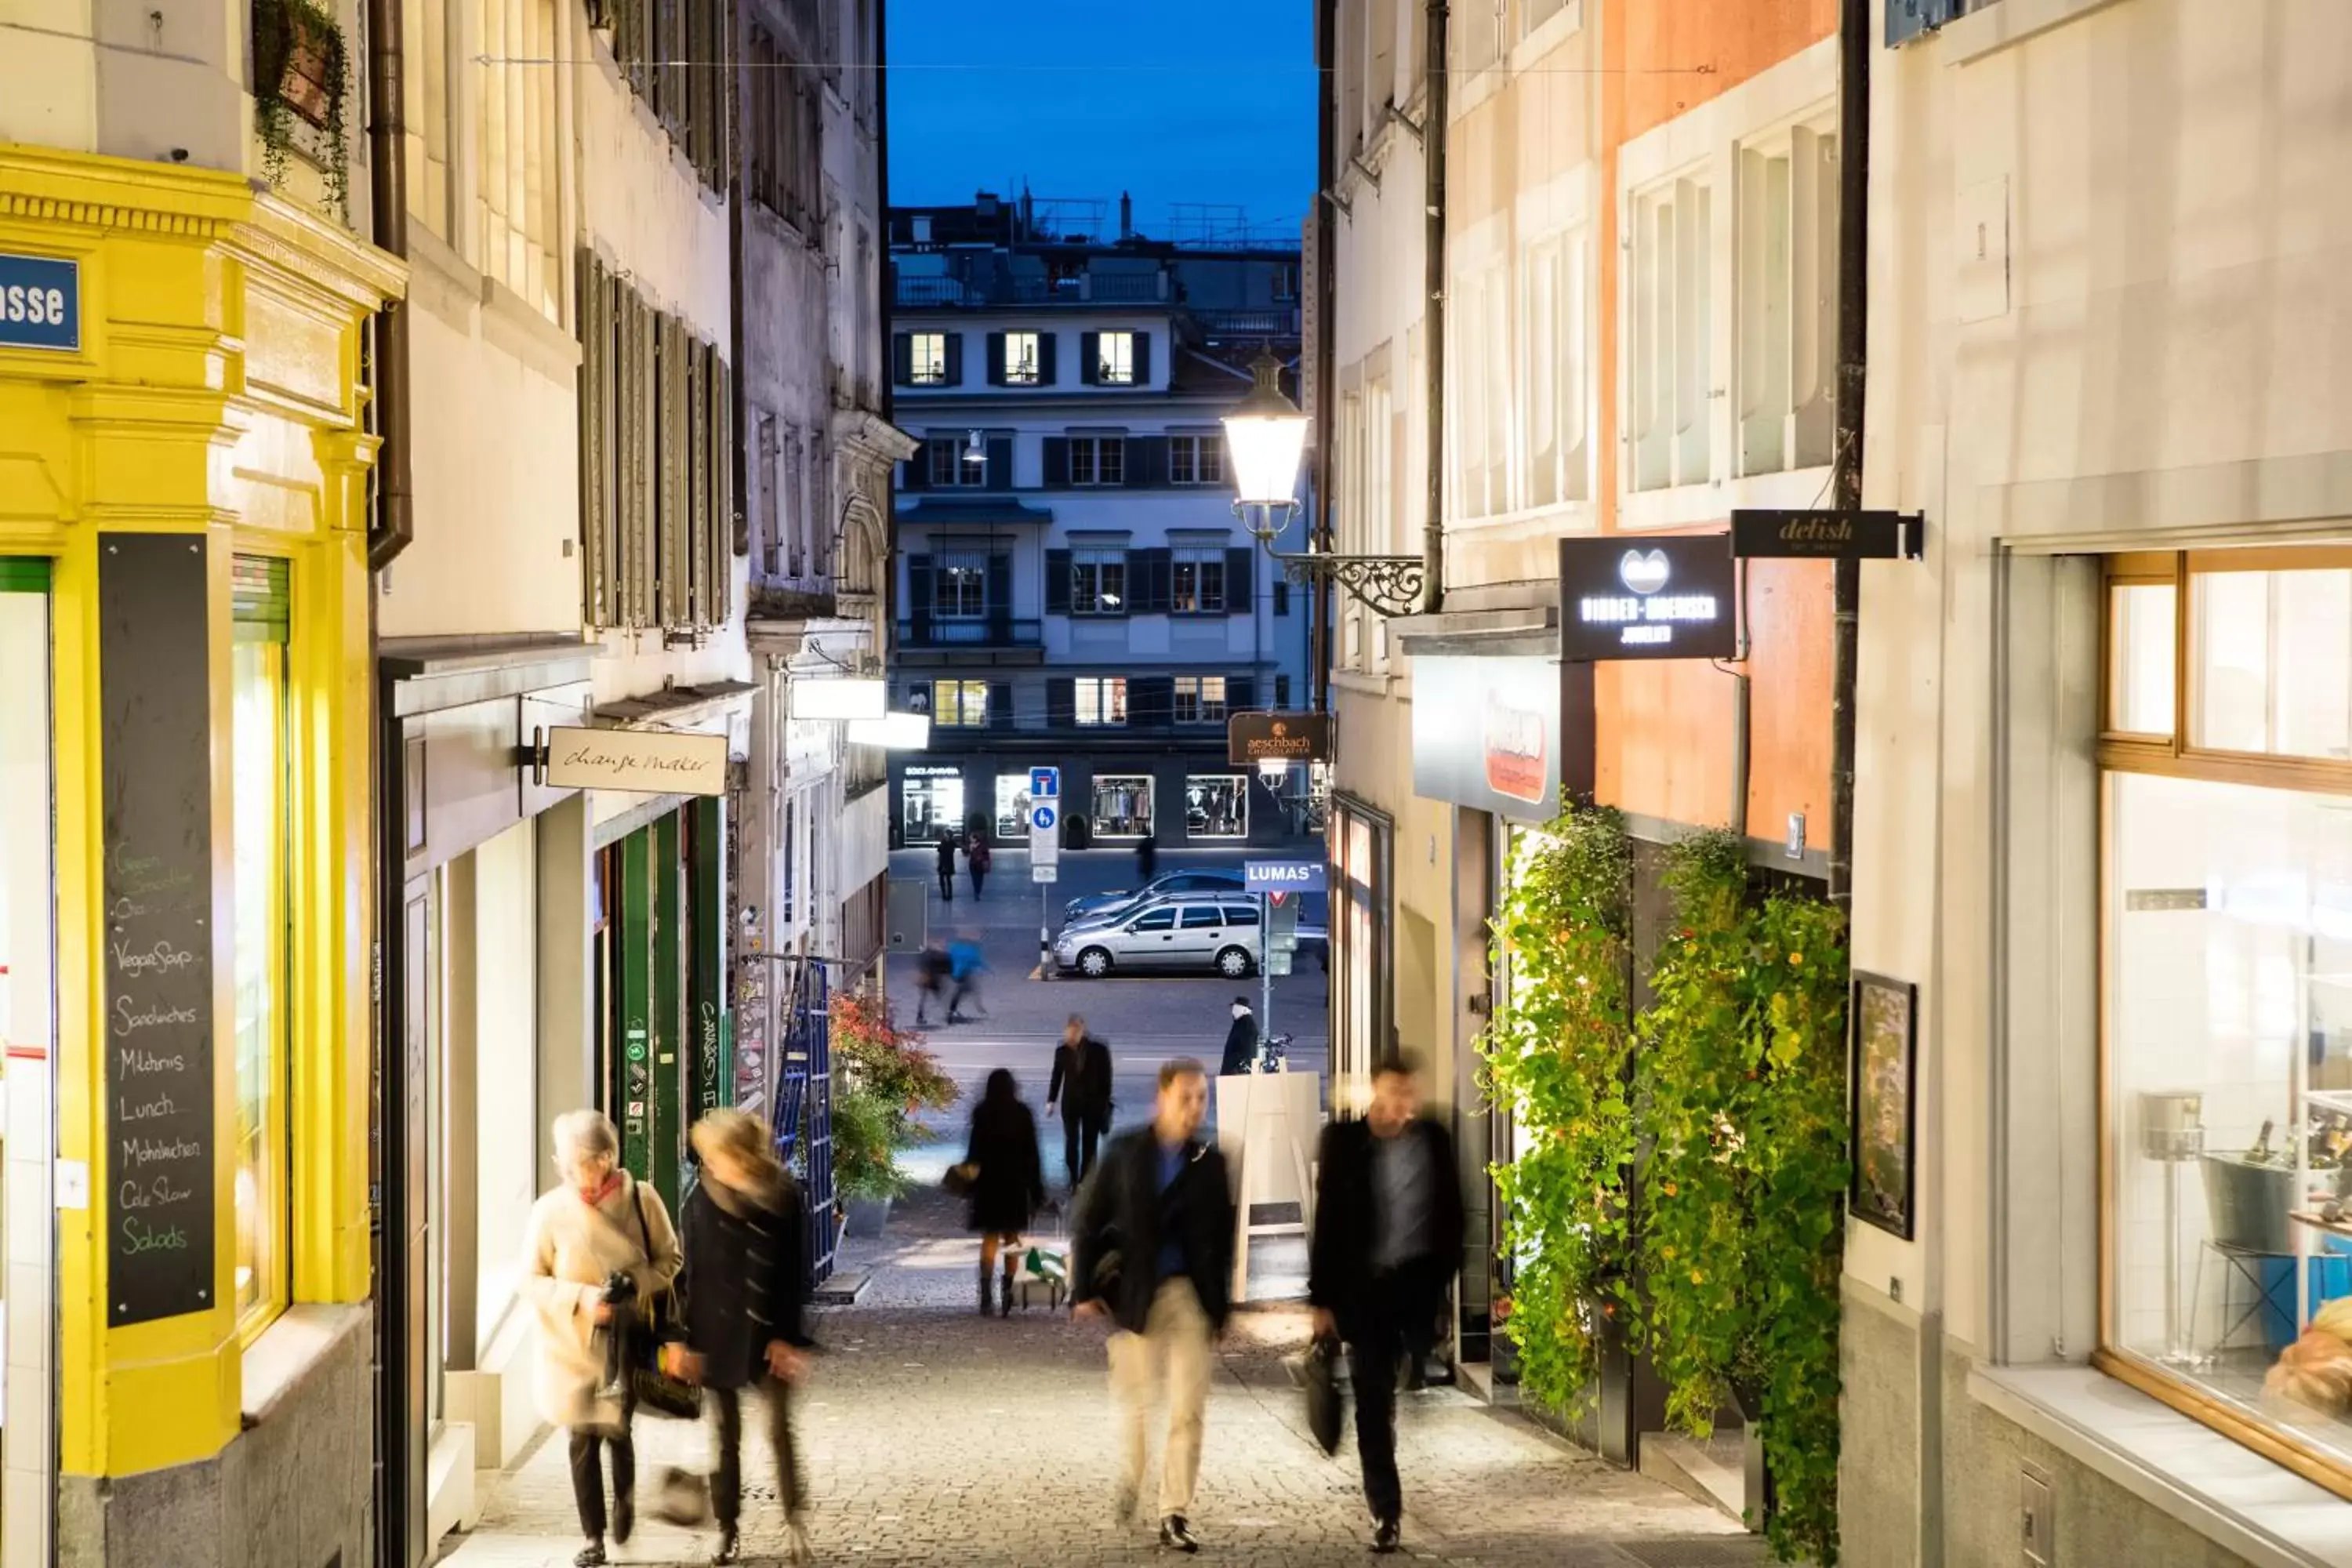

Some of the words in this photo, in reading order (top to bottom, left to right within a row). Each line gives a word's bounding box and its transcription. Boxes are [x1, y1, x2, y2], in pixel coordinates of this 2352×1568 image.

[1779, 517, 1852, 540] delish
[1247, 736, 1310, 748] aeschbach
[1249, 866, 1310, 881] LUMAS
[120, 1091, 176, 1122] Lunch
